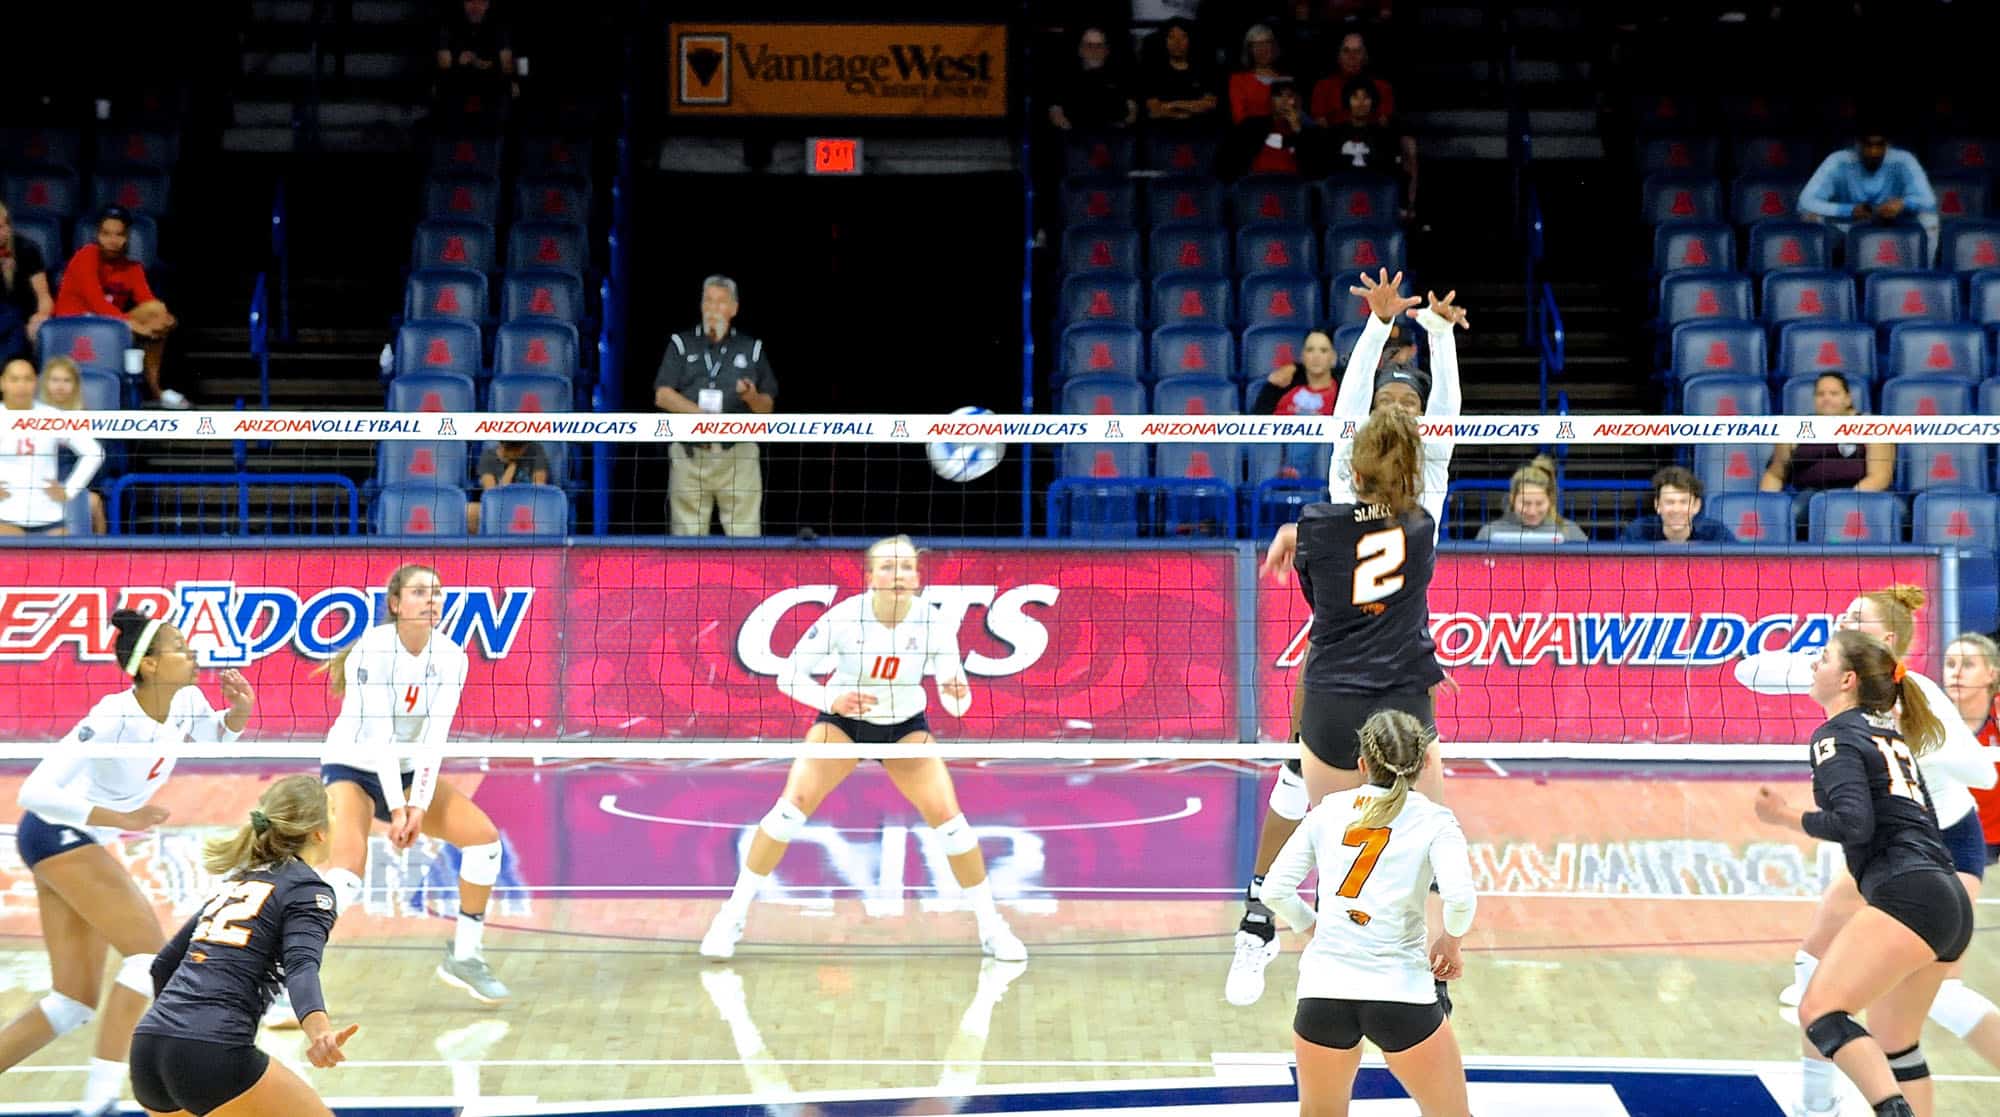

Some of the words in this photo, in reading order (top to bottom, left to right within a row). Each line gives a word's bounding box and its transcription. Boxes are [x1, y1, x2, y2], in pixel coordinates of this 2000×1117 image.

[1417, 423, 1540, 437] ONAWILDCATS
[1351, 525, 1408, 606] 2
[870, 655, 901, 681] 10
[404, 685, 420, 713] 4
[1812, 736, 1838, 766] 13
[1335, 825, 1393, 899] 7
